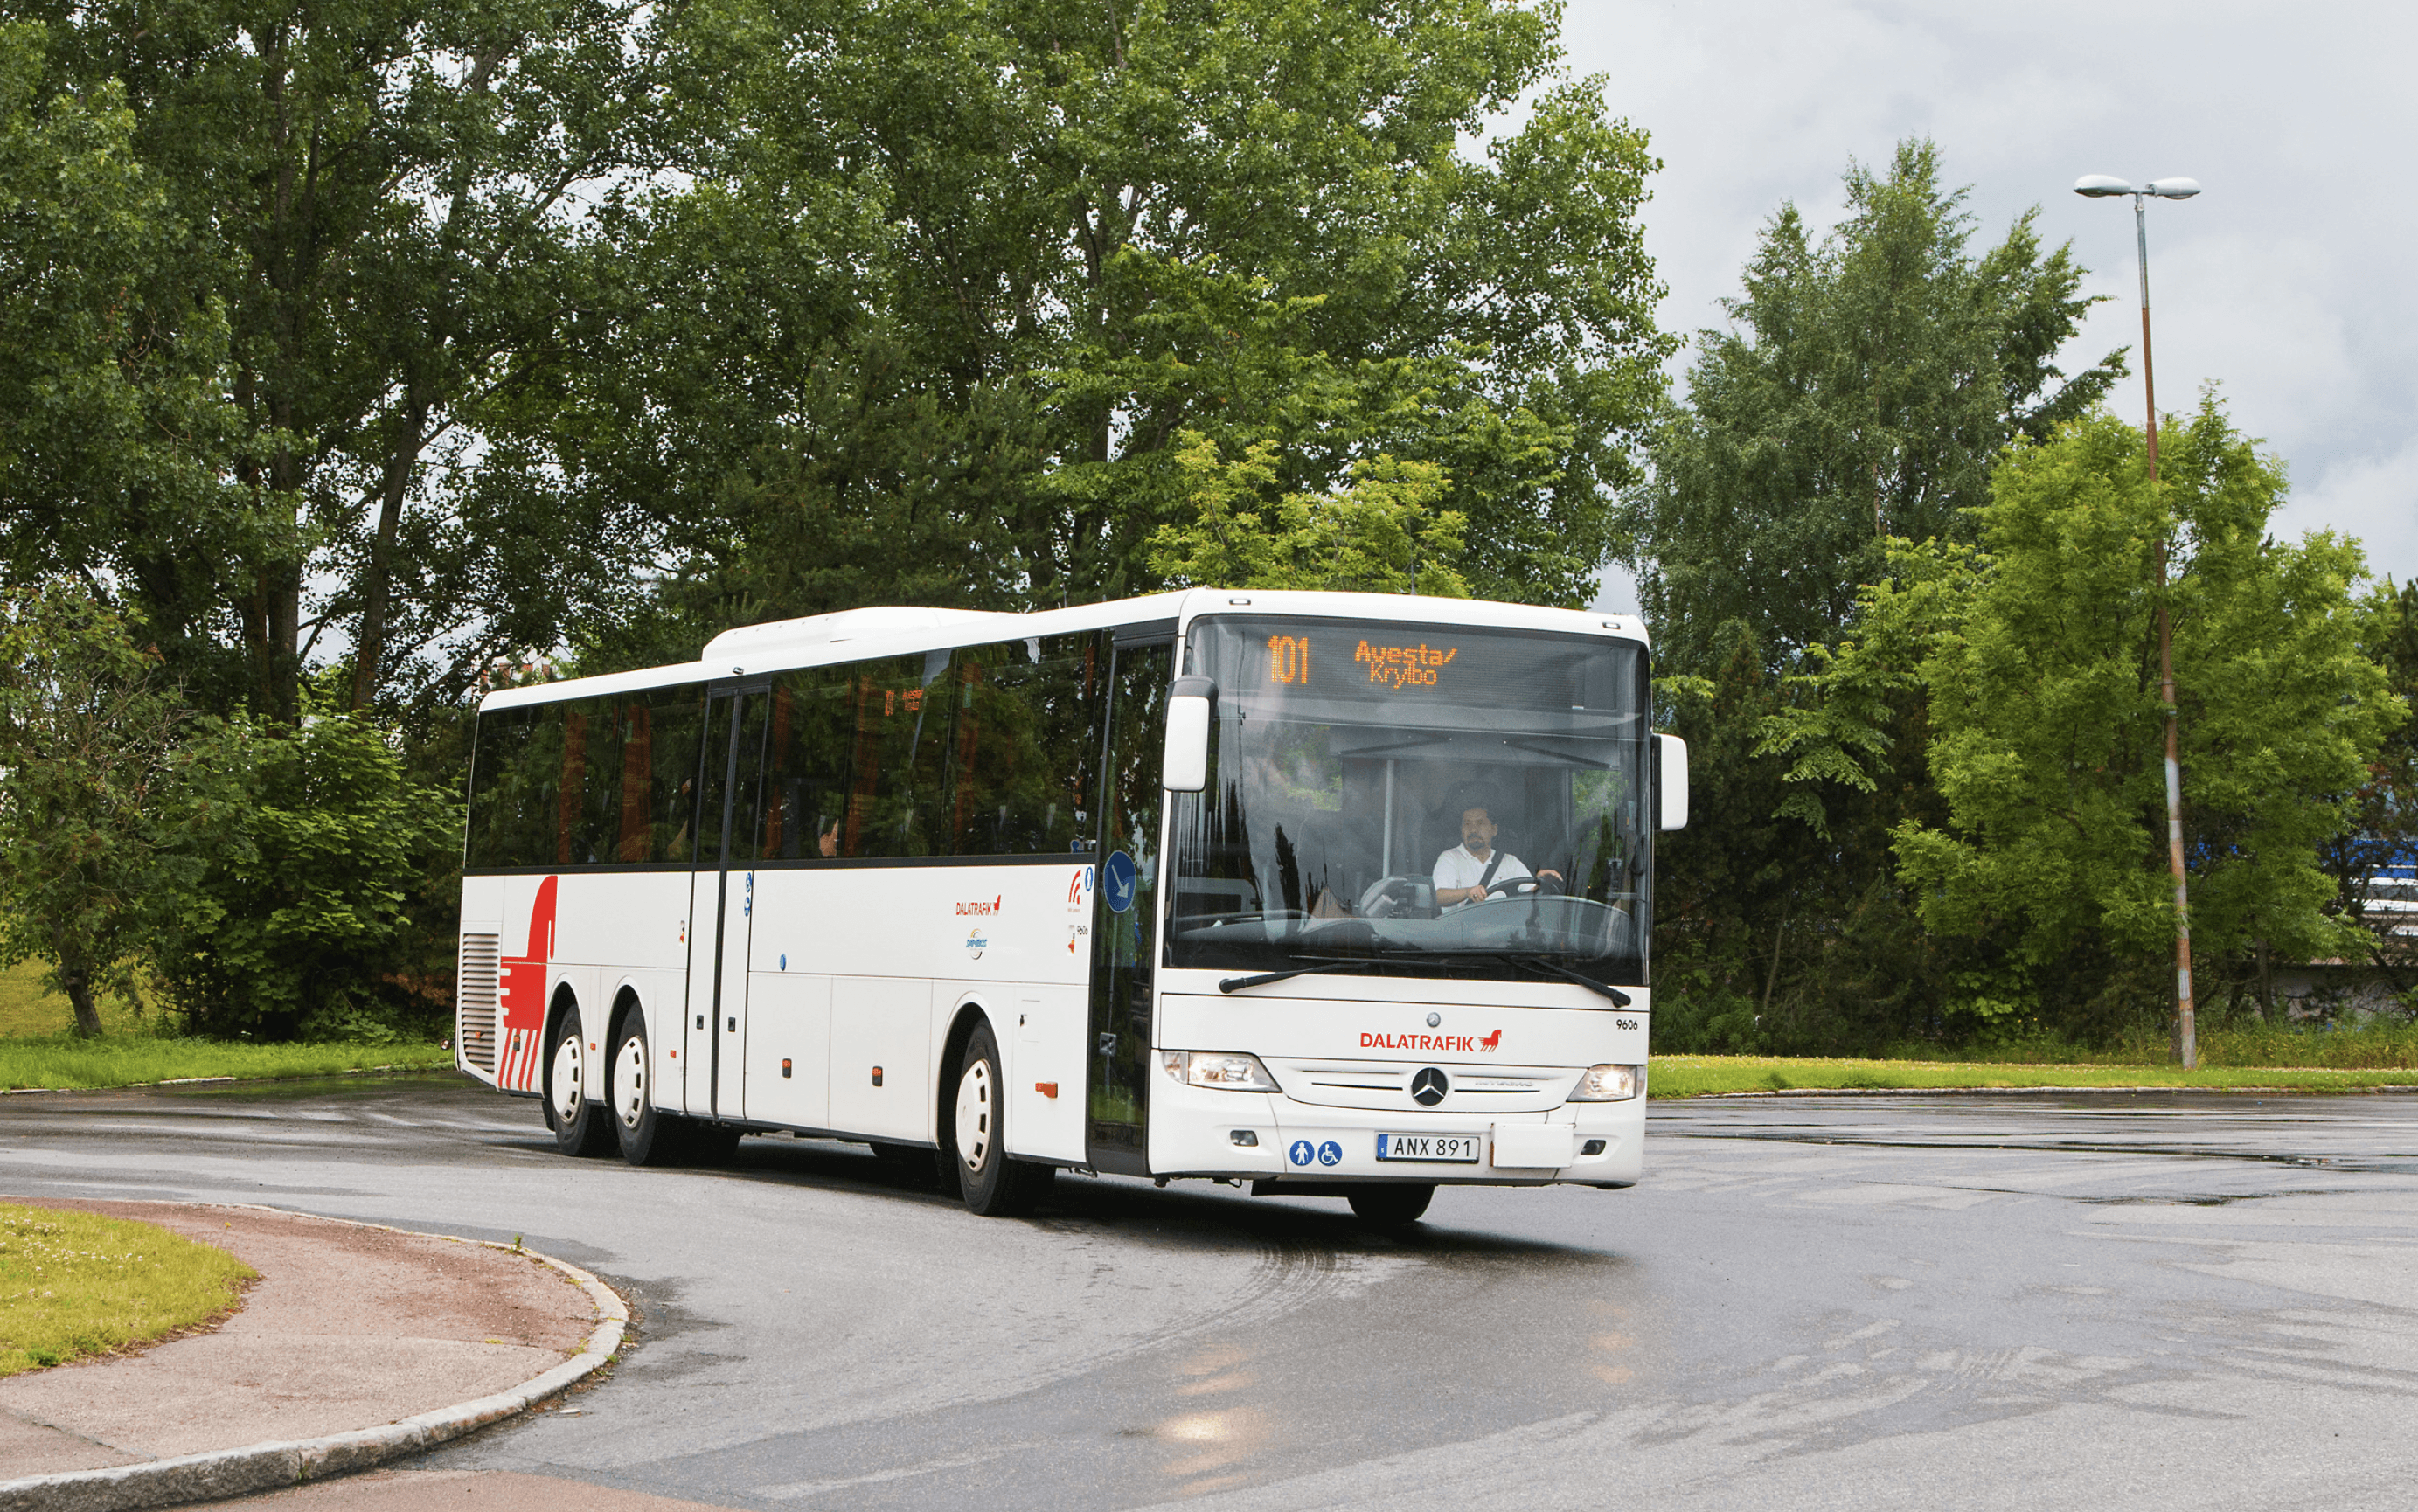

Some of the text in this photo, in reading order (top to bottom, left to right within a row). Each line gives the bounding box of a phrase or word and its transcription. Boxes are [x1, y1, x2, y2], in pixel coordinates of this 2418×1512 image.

[1268, 635, 1309, 683] 101
[1355, 640, 1458, 665] Avesta/
[1370, 661, 1437, 689] Krylbo
[955, 901, 991, 916] DALATRAFIK
[1616, 1018, 1638, 1030] 9606
[1360, 1032, 1474, 1051] DALATRAFIK
[1393, 1137, 1429, 1155] ANX
[1436, 1139, 1470, 1157] 891
